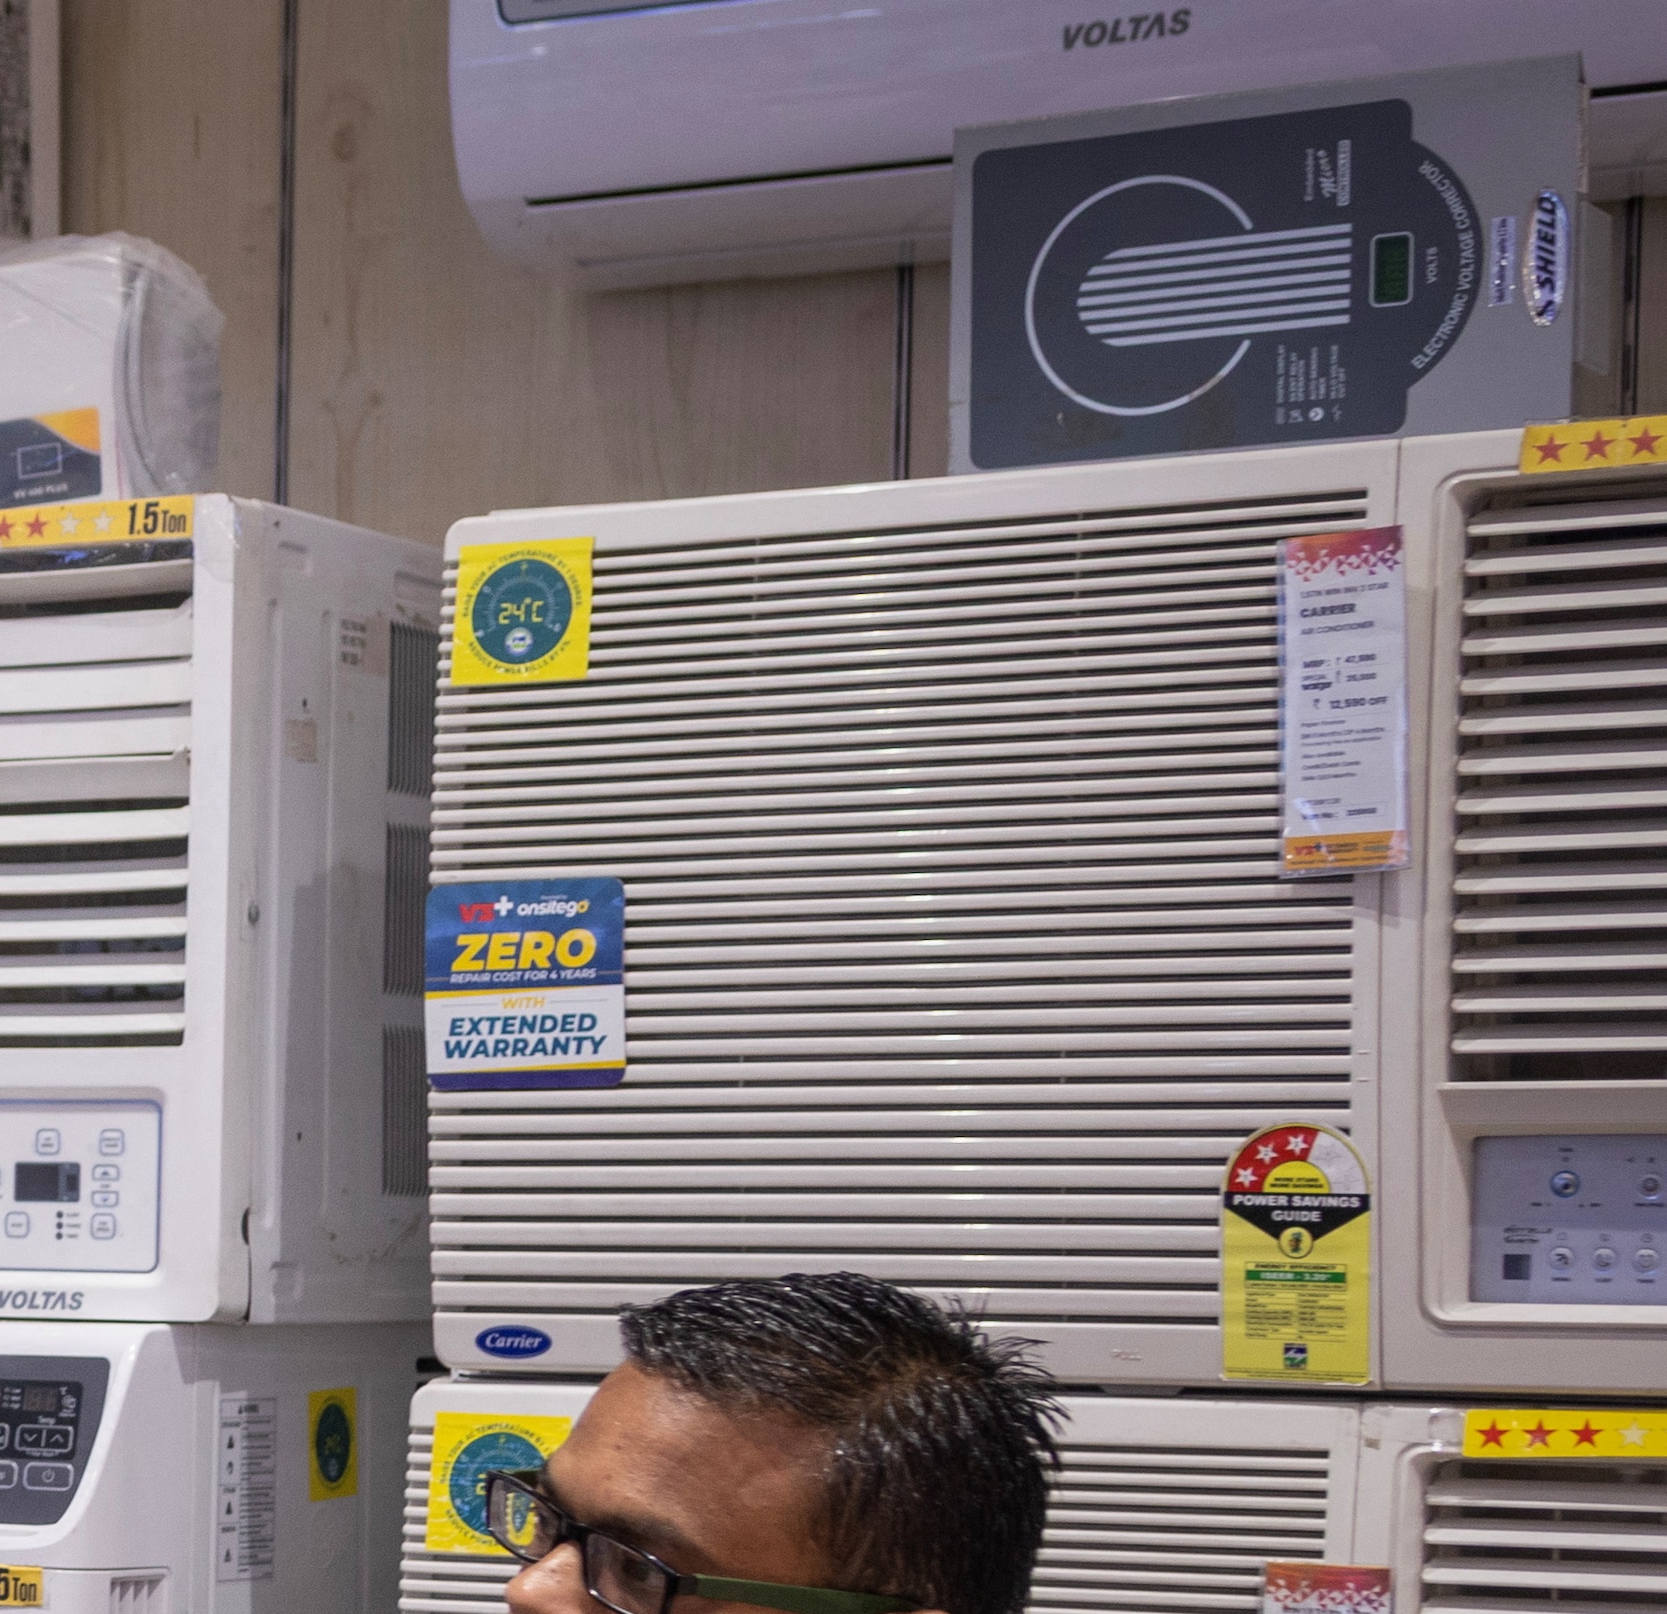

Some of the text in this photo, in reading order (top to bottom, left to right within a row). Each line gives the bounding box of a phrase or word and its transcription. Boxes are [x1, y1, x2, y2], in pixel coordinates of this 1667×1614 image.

[1062, 7, 1192, 52] VOLTAS
[1411, 158, 1475, 370] ELECTRONIC VOLTAGE CORRECTOR
[1426, 246, 1439, 283] VOLTS
[128, 503, 187, 535] 1.5 Ton
[1300, 603, 1356, 618] CARRIER
[1369, 695, 1389, 706] OFF
[517, 898, 591, 918] onsitego
[451, 928, 598, 972] ZERO
[450, 968, 597, 984] REPAIR COST FOR 4 YEARS
[501, 996, 546, 1010] WITH
[449, 1013, 598, 1037] EXTENDED
[444, 1035, 607, 1059] WARRANTY
[1233, 1194, 1361, 1208] POWER SAVINGS
[1271, 1210, 1323, 1222] GUIDE
[485, 1332, 543, 1349] Carrier
[13, 1577, 38, 1603] Ton
